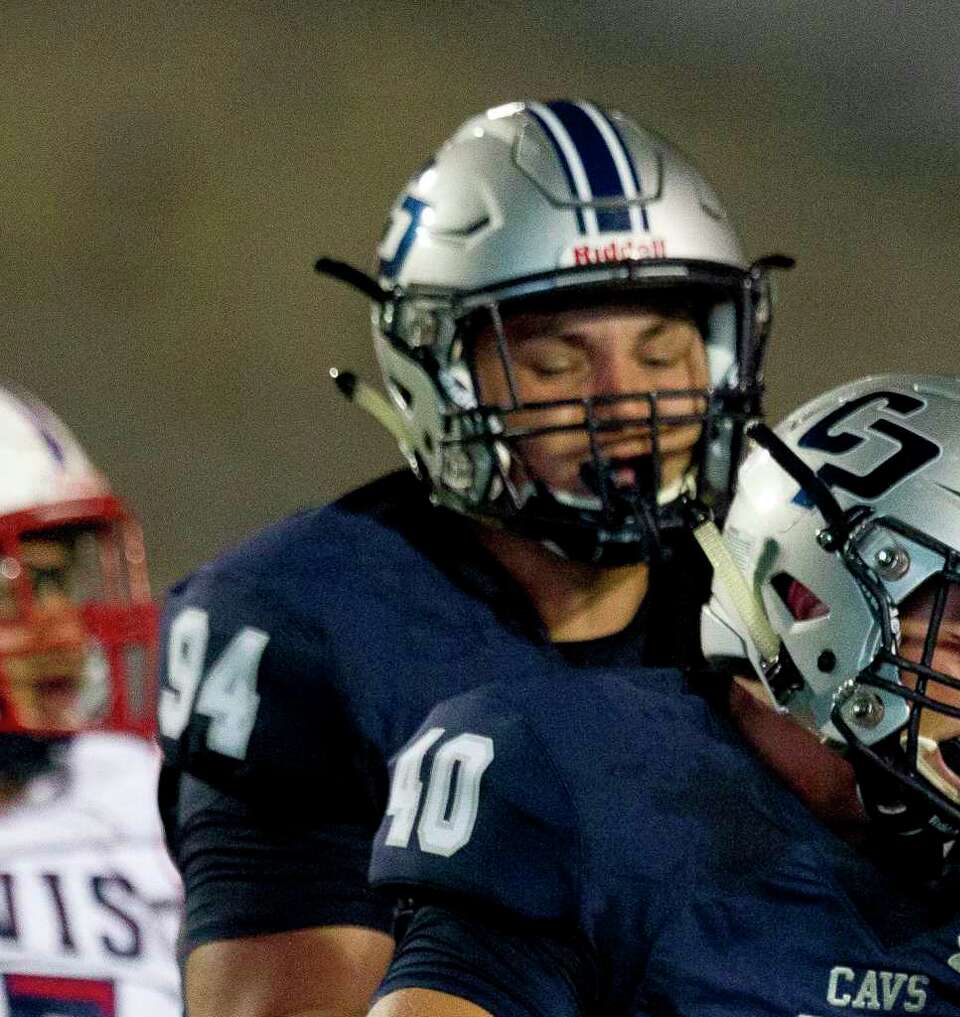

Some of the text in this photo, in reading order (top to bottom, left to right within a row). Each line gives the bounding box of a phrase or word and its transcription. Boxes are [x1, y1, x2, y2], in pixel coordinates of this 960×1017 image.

[157, 607, 270, 761] 94
[385, 727, 495, 858] 40
[826, 966, 930, 1013] CAVS
